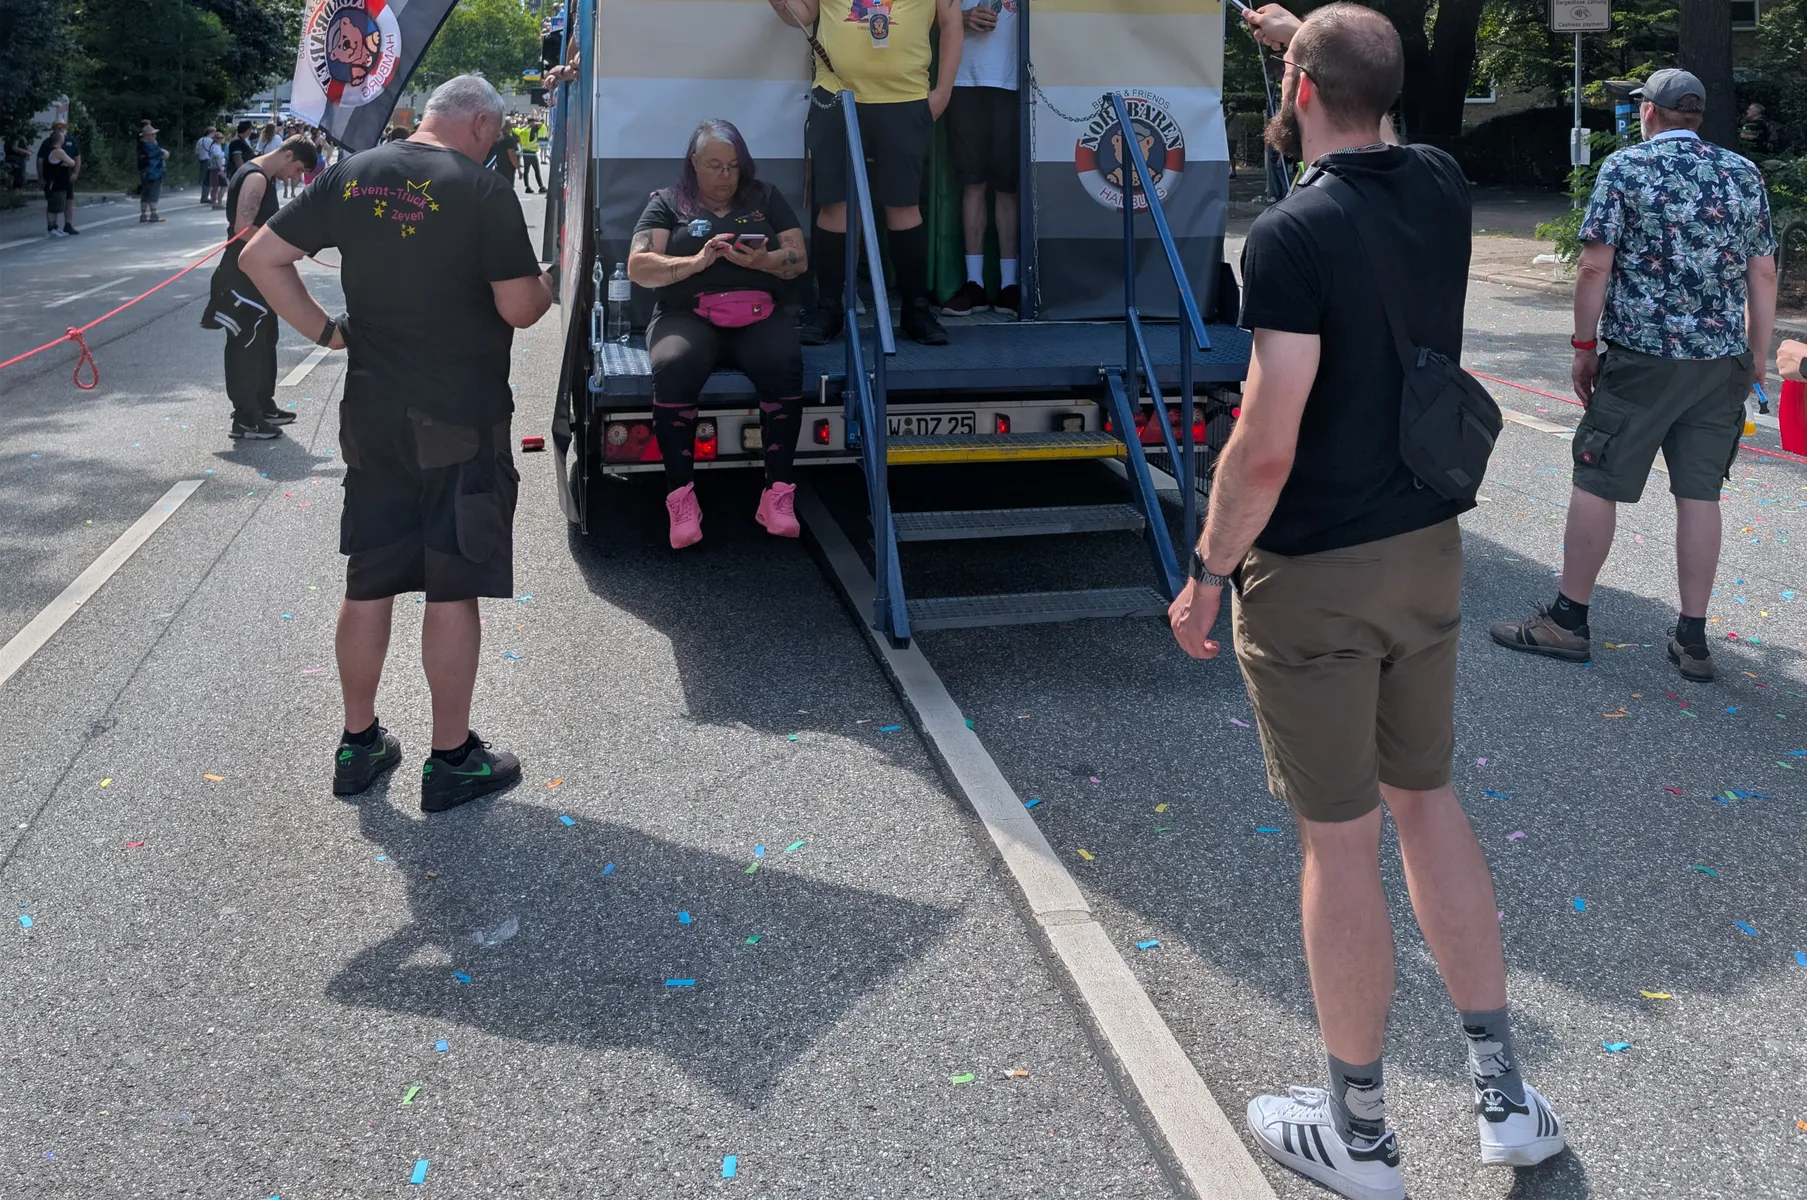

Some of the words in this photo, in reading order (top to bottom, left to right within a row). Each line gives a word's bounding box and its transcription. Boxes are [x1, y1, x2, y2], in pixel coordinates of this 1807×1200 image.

[1123, 89, 1130, 97] &
[1132, 89, 1171, 110] FRIENDS
[1080, 101, 1183, 150] NORBÄREN
[1618, 120, 1626, 132] P
[351, 184, 429, 210] Event-Truck
[391, 208, 425, 222] Zeven
